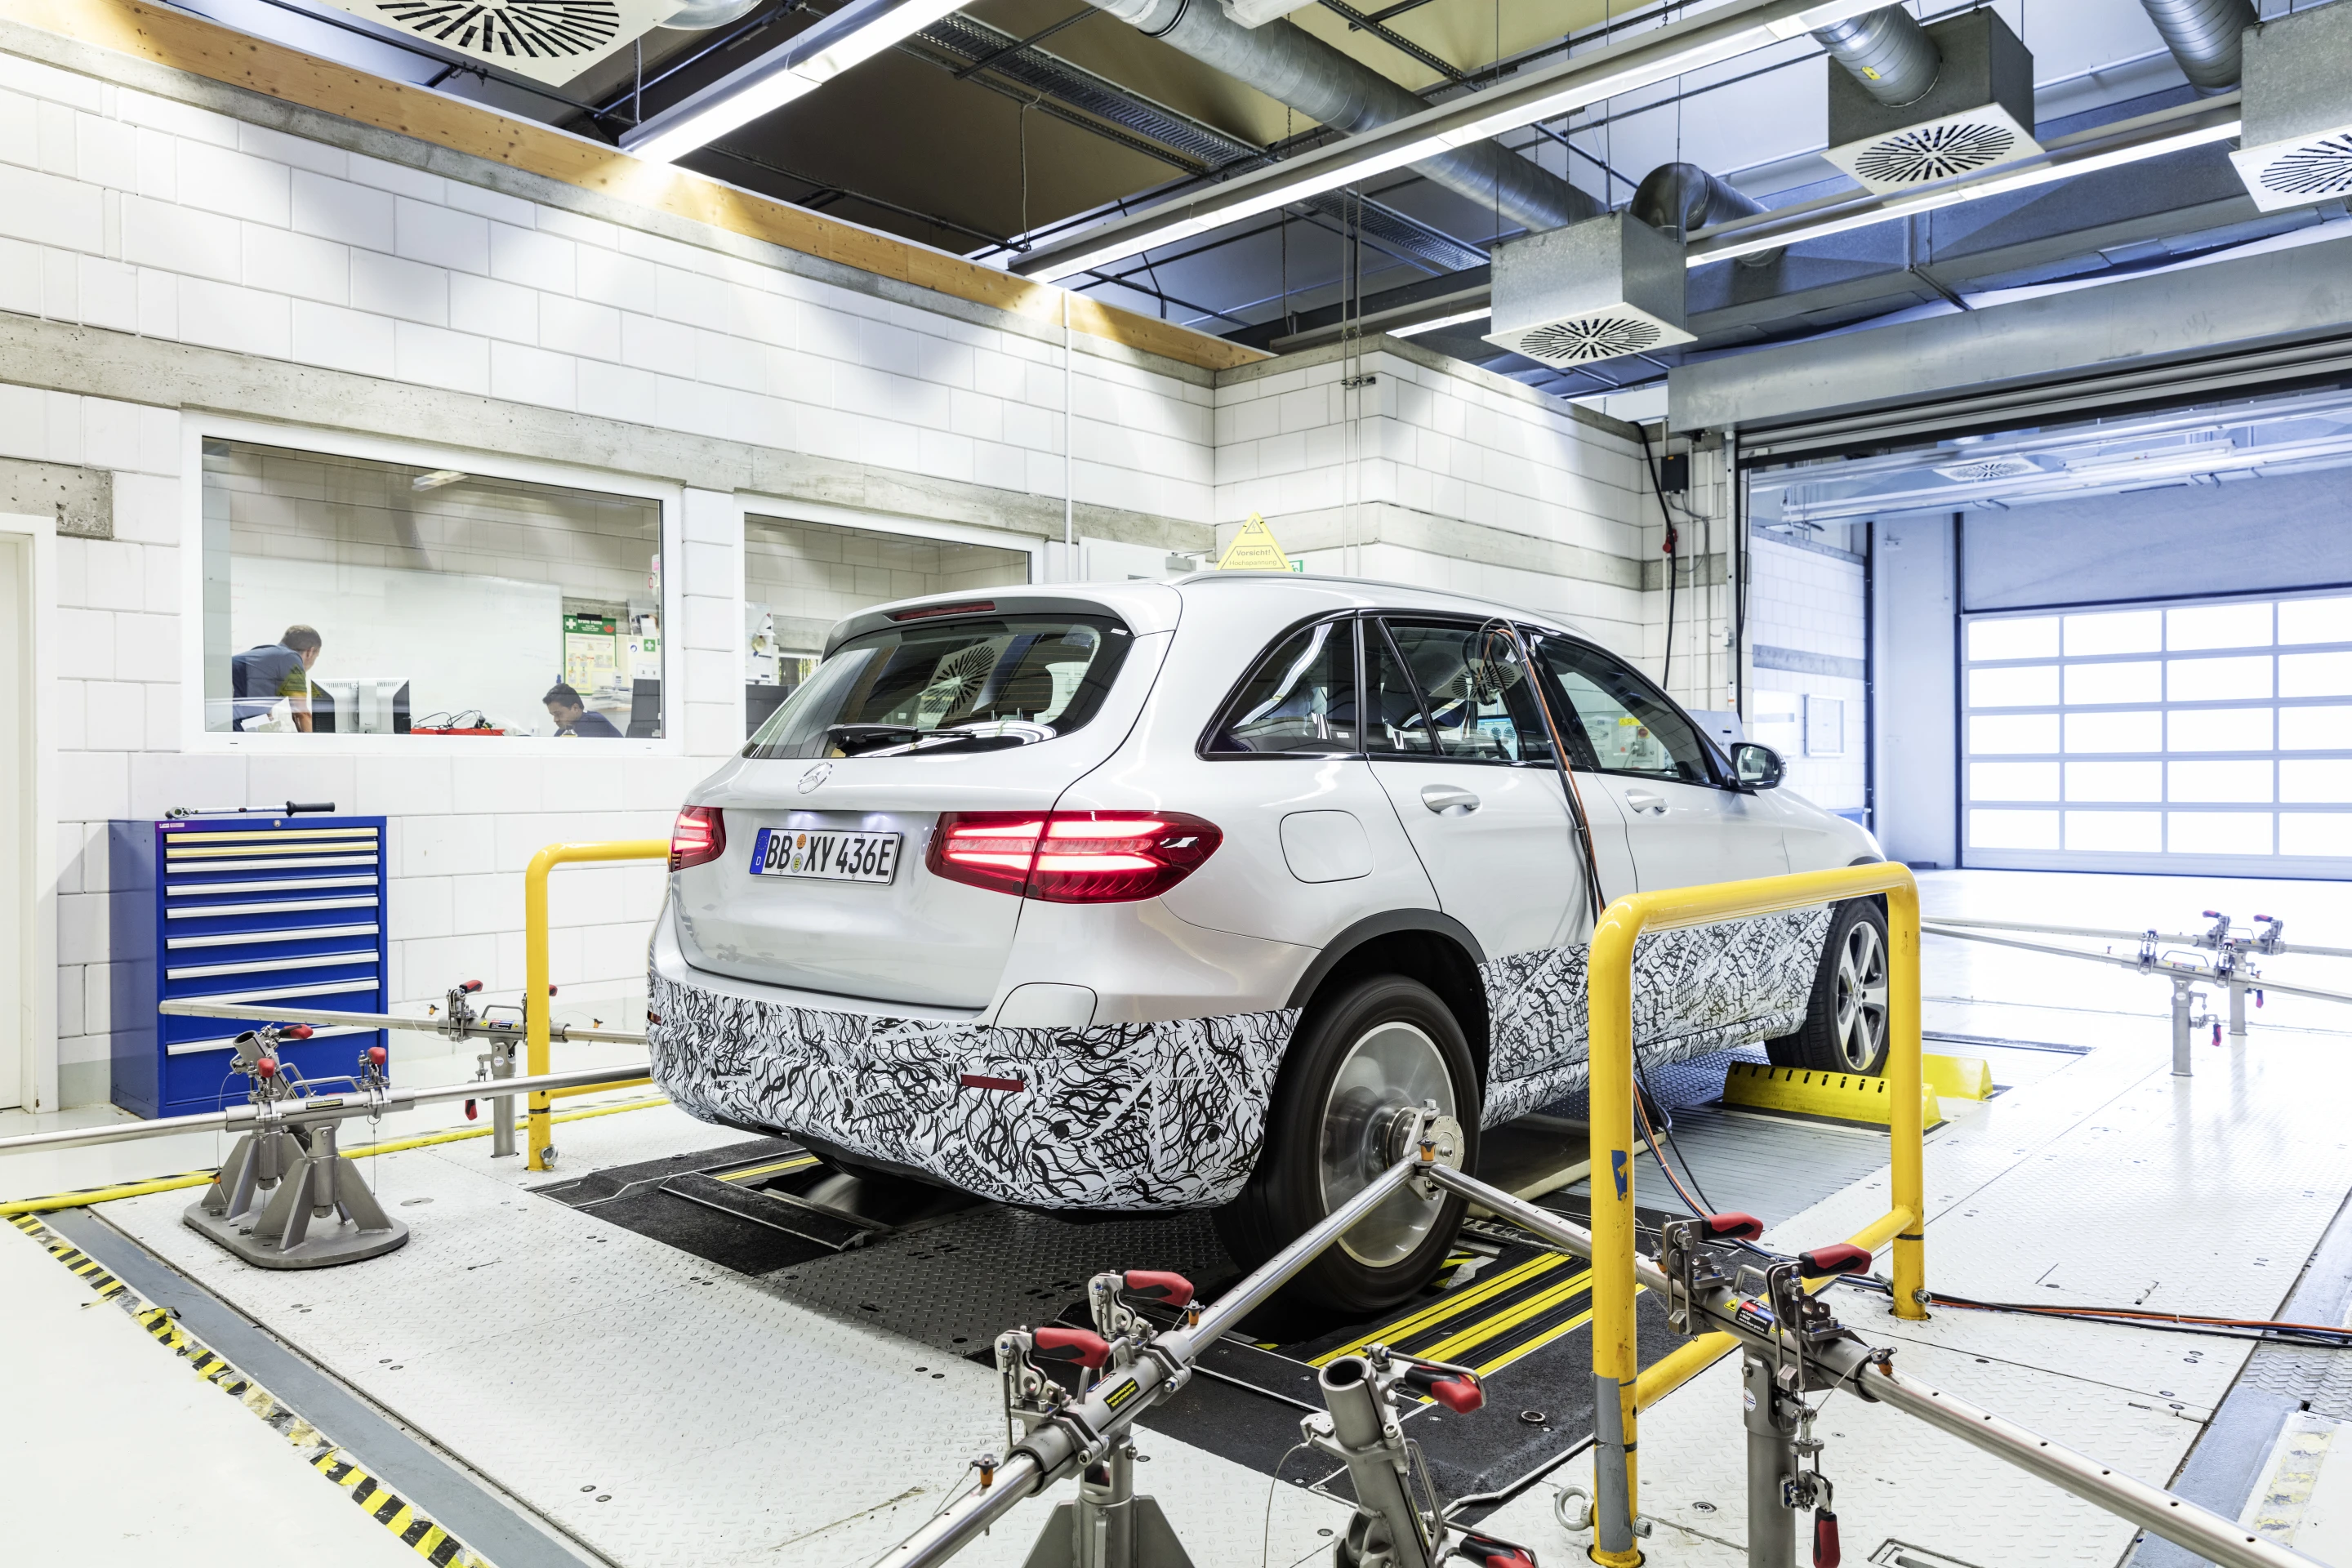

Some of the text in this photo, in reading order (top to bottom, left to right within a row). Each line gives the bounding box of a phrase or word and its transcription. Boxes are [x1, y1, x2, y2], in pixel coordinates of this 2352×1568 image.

[755, 856, 762, 866] D
[764, 835, 895, 876] BB XY 436E
